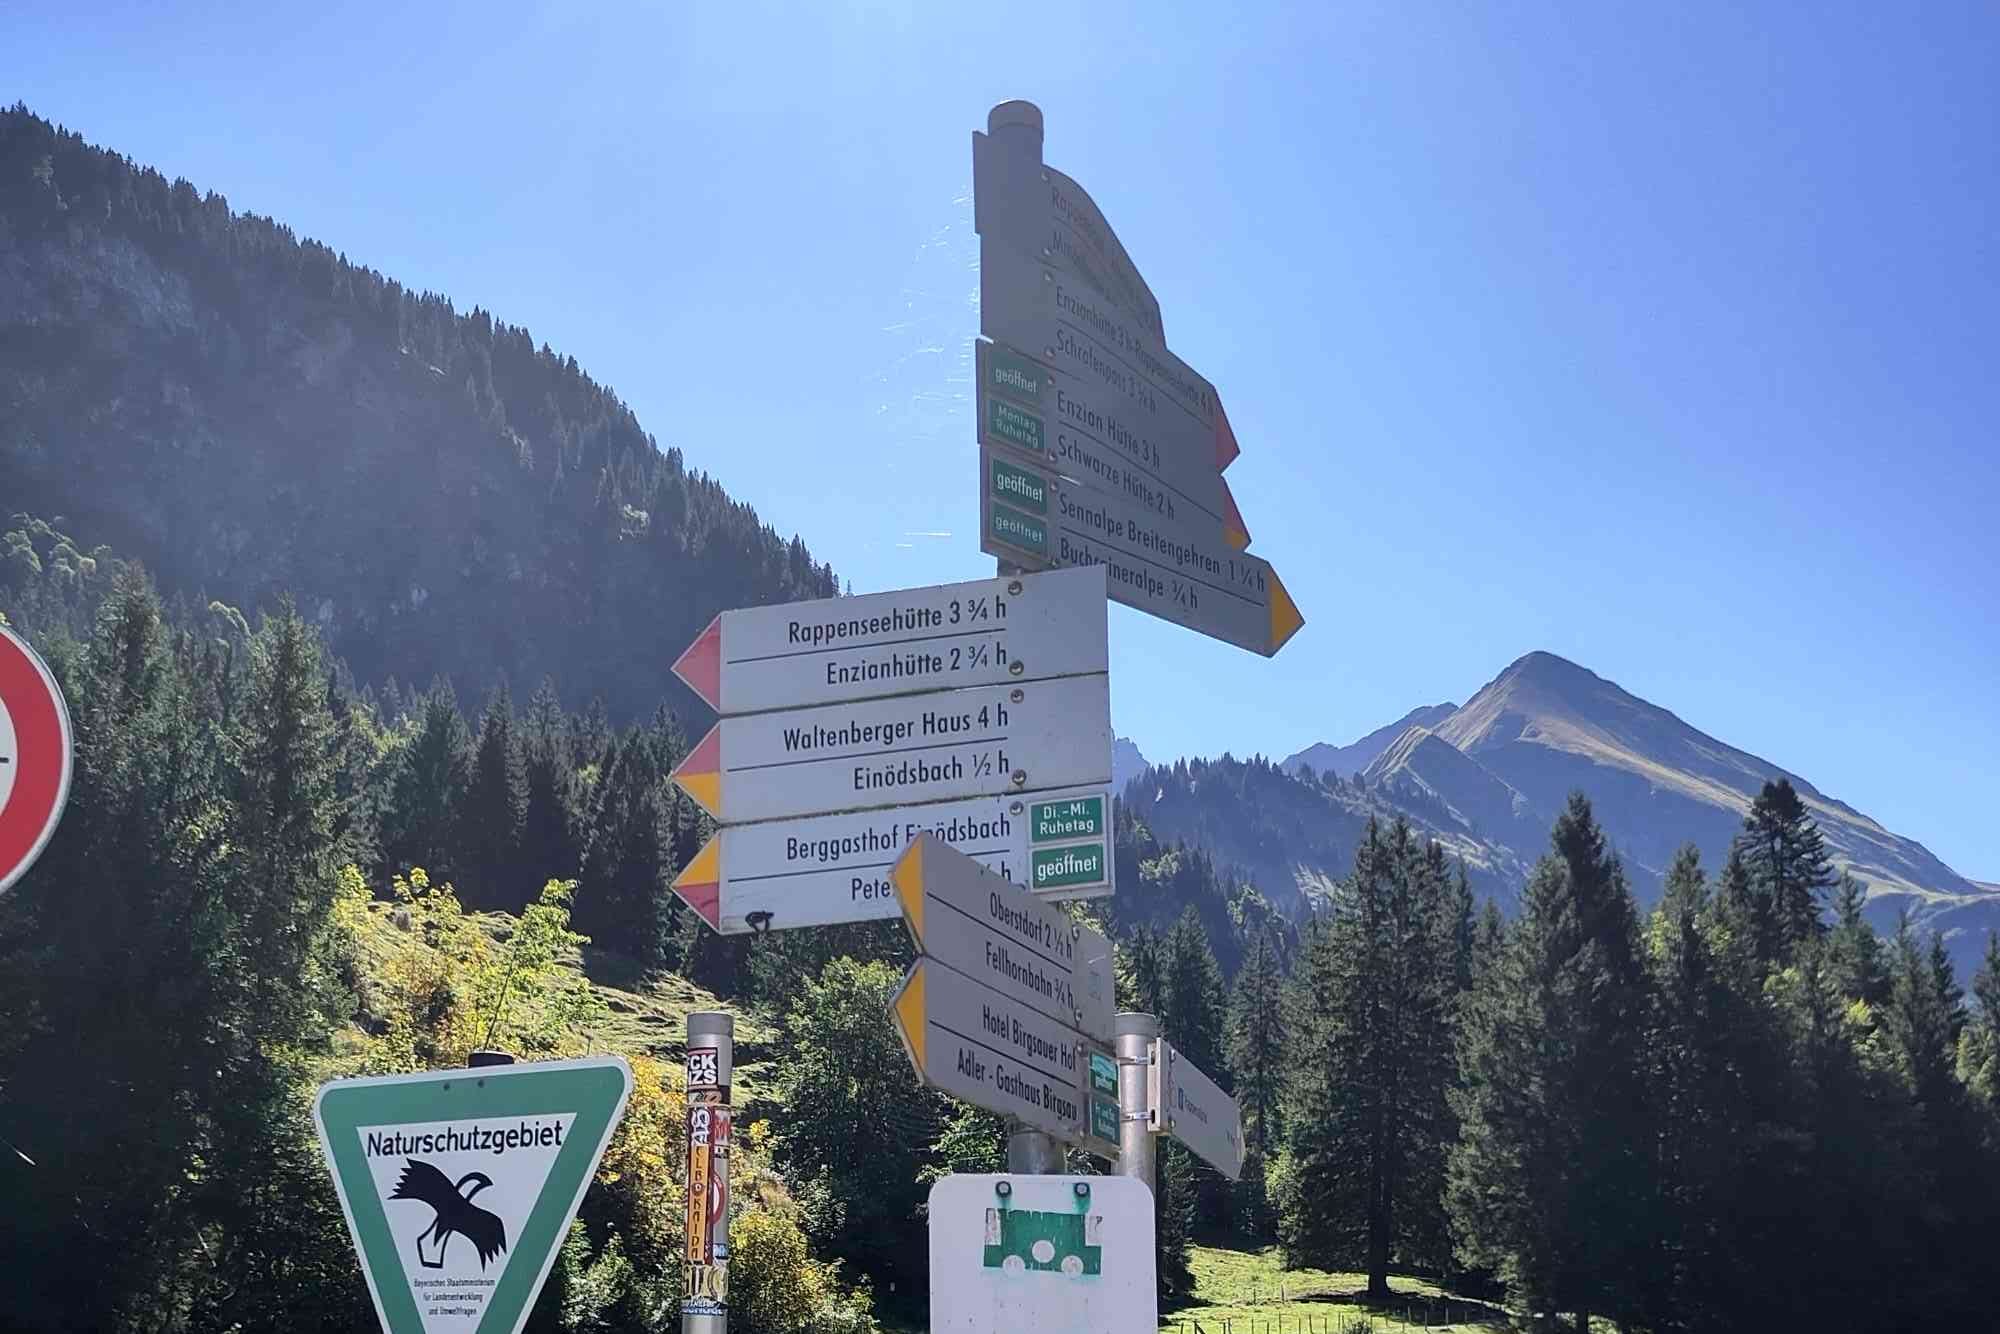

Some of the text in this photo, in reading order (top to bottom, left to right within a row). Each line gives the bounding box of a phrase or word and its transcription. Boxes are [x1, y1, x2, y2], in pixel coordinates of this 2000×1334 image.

[994, 367, 1037, 393] geöffnet
[996, 417, 1039, 448] Ruhetag
[998, 405, 1038, 432] Montag
[1057, 389, 1160, 470] Enzian Hütte 3 h
[996, 472, 1043, 502] geöffnet
[1058, 434, 1175, 520] Schwarze Hütte 2 h
[995, 516, 1043, 543] geöffnet
[1059, 492, 1123, 537] Sennalpe
[1128, 519, 1220, 575] Breitengehren
[1257, 570, 1264, 592] h
[1060, 537, 1164, 598] Buchineralpe
[1190, 586, 1198, 609] h
[788, 595, 1006, 646] Rappenseehütte 3 ¾ h
[827, 641, 1007, 685] Enzianhütte 2 ¾ h
[784, 703, 1008, 751] Waltenberger Haus 4 h
[854, 750, 1009, 790] Einödsbach ½ h
[787, 812, 1010, 862] Berggasthof Eödsbach
[1039, 819, 1095, 835] Ruhetag
[851, 877, 891, 901] Pete
[1037, 854, 1097, 881] geöffnet
[990, 891, 1043, 945] Oberstdorf
[985, 941, 1053, 999] Fellhornbahn
[983, 1003, 1076, 1072] Hotel Birgsauer Hof
[688, 1054, 717, 1070] CK
[957, 1047, 986, 1082] Adler
[996, 1064, 1041, 1107] Gasthaus
[1043, 1083, 1078, 1121] Birgsau
[367, 1120, 562, 1158] Naturschutzgebiet
